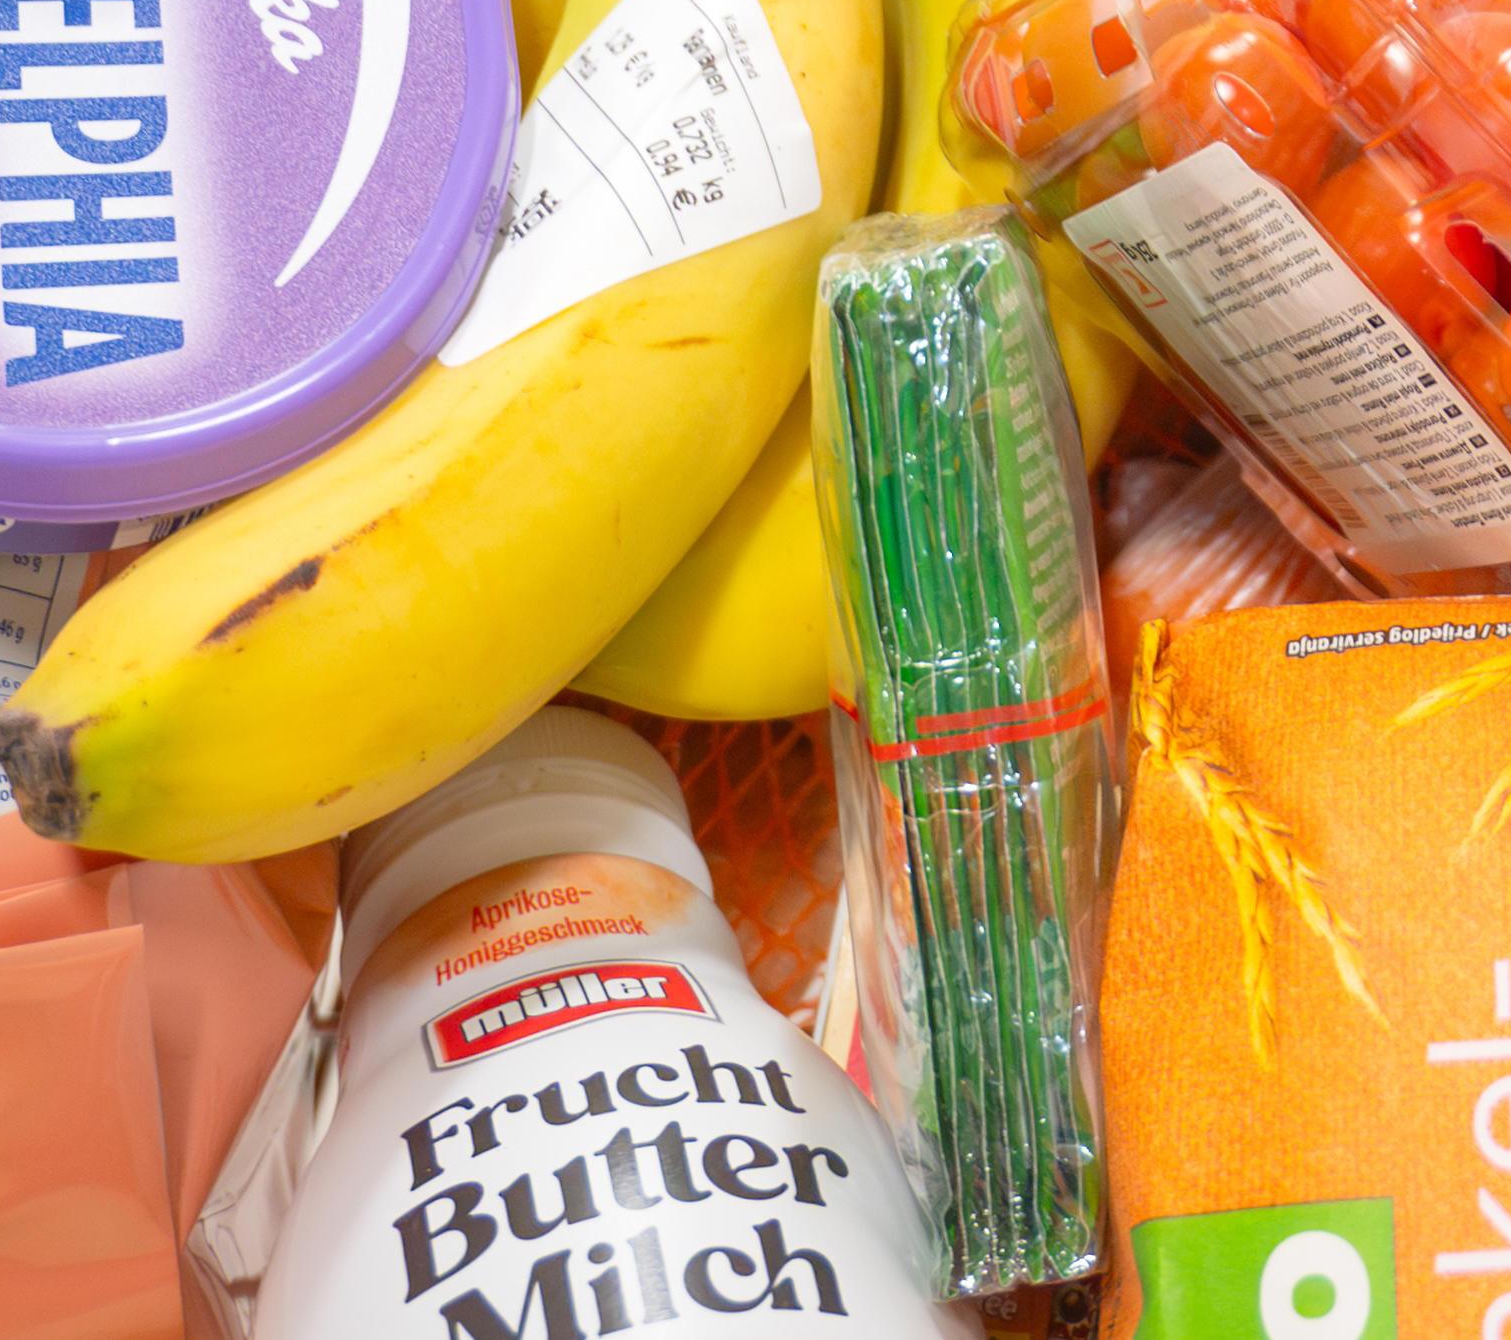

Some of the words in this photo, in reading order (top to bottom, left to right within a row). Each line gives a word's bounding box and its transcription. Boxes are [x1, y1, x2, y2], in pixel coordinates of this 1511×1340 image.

[671, 188, 698, 212] €
[701, 176, 725, 204] kg
[1287, 630, 1385, 658] serviranja
[1388, 622, 1477, 647] Prijedlog
[470, 883, 593, 933] Aprikose-
[433, 913, 650, 987] Honiggeschmack
[460, 972, 668, 1044] müller
[401, 1044, 807, 1193] Frucht
[392, 1120, 850, 1304] Butter
[436, 1218, 850, 1340] Milch
